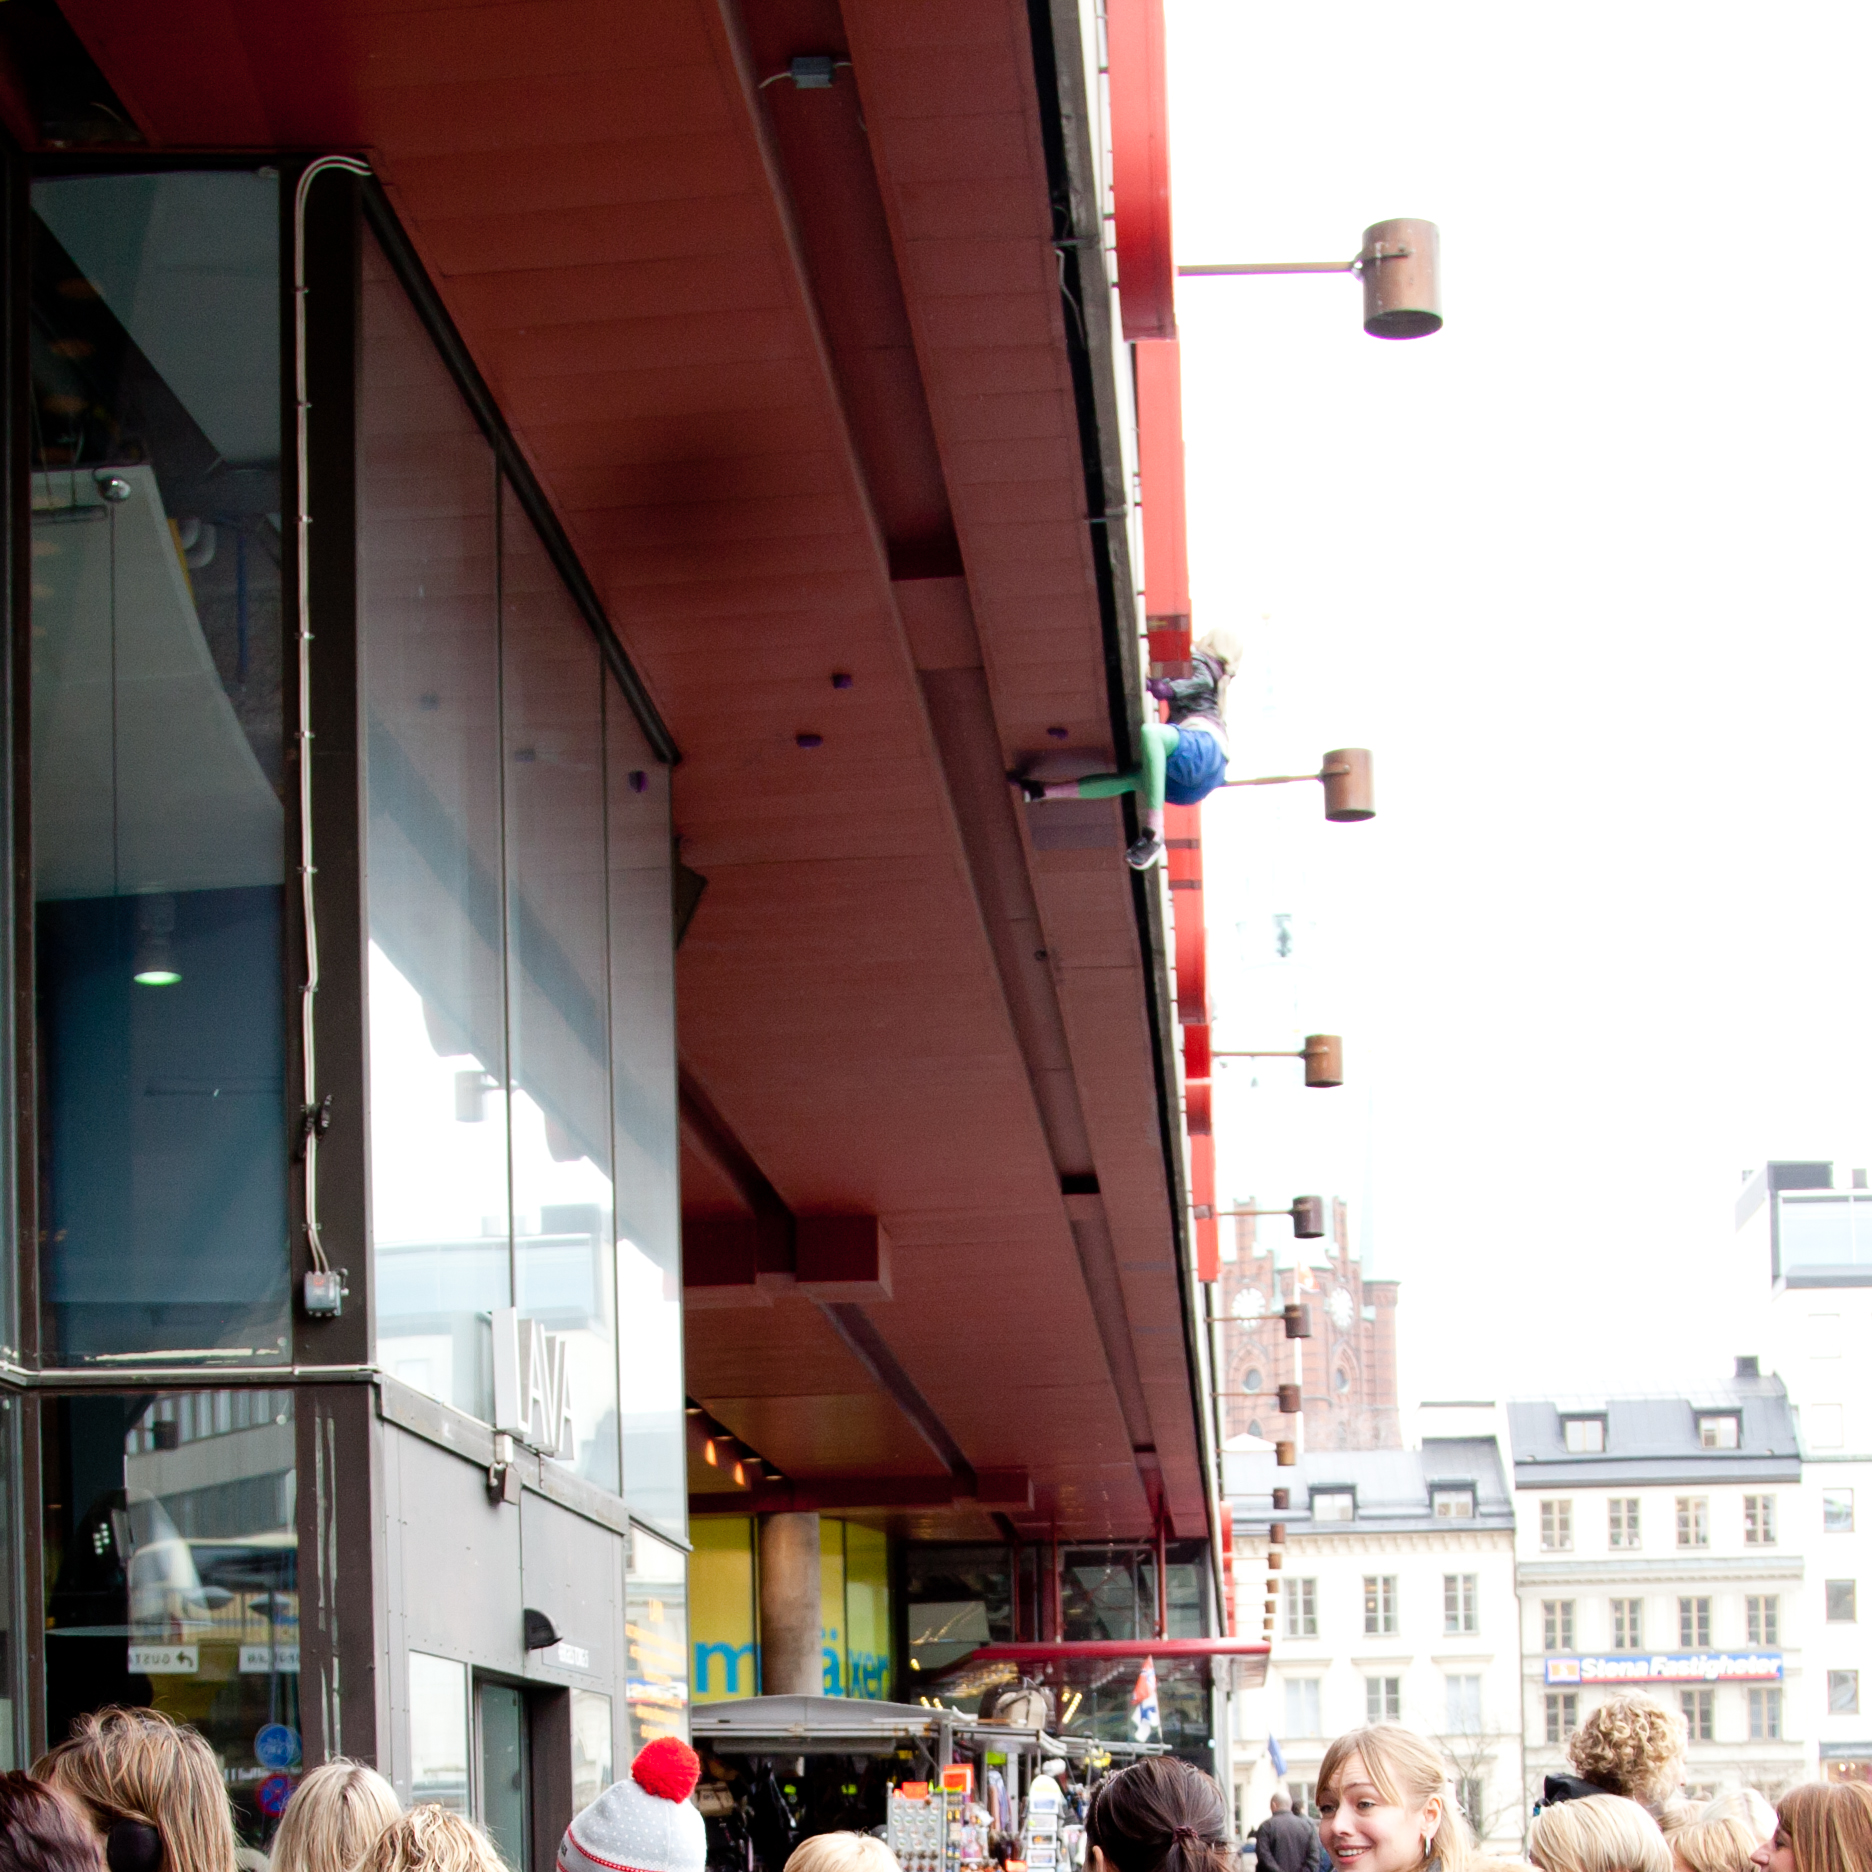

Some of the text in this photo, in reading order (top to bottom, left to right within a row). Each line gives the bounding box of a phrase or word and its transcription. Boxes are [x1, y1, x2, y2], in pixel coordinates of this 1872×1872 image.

[492, 1306, 575, 1460] LAVA
[1581, 1658, 1649, 1678] Stena
[1650, 1655, 1781, 1680] Fastigheter
